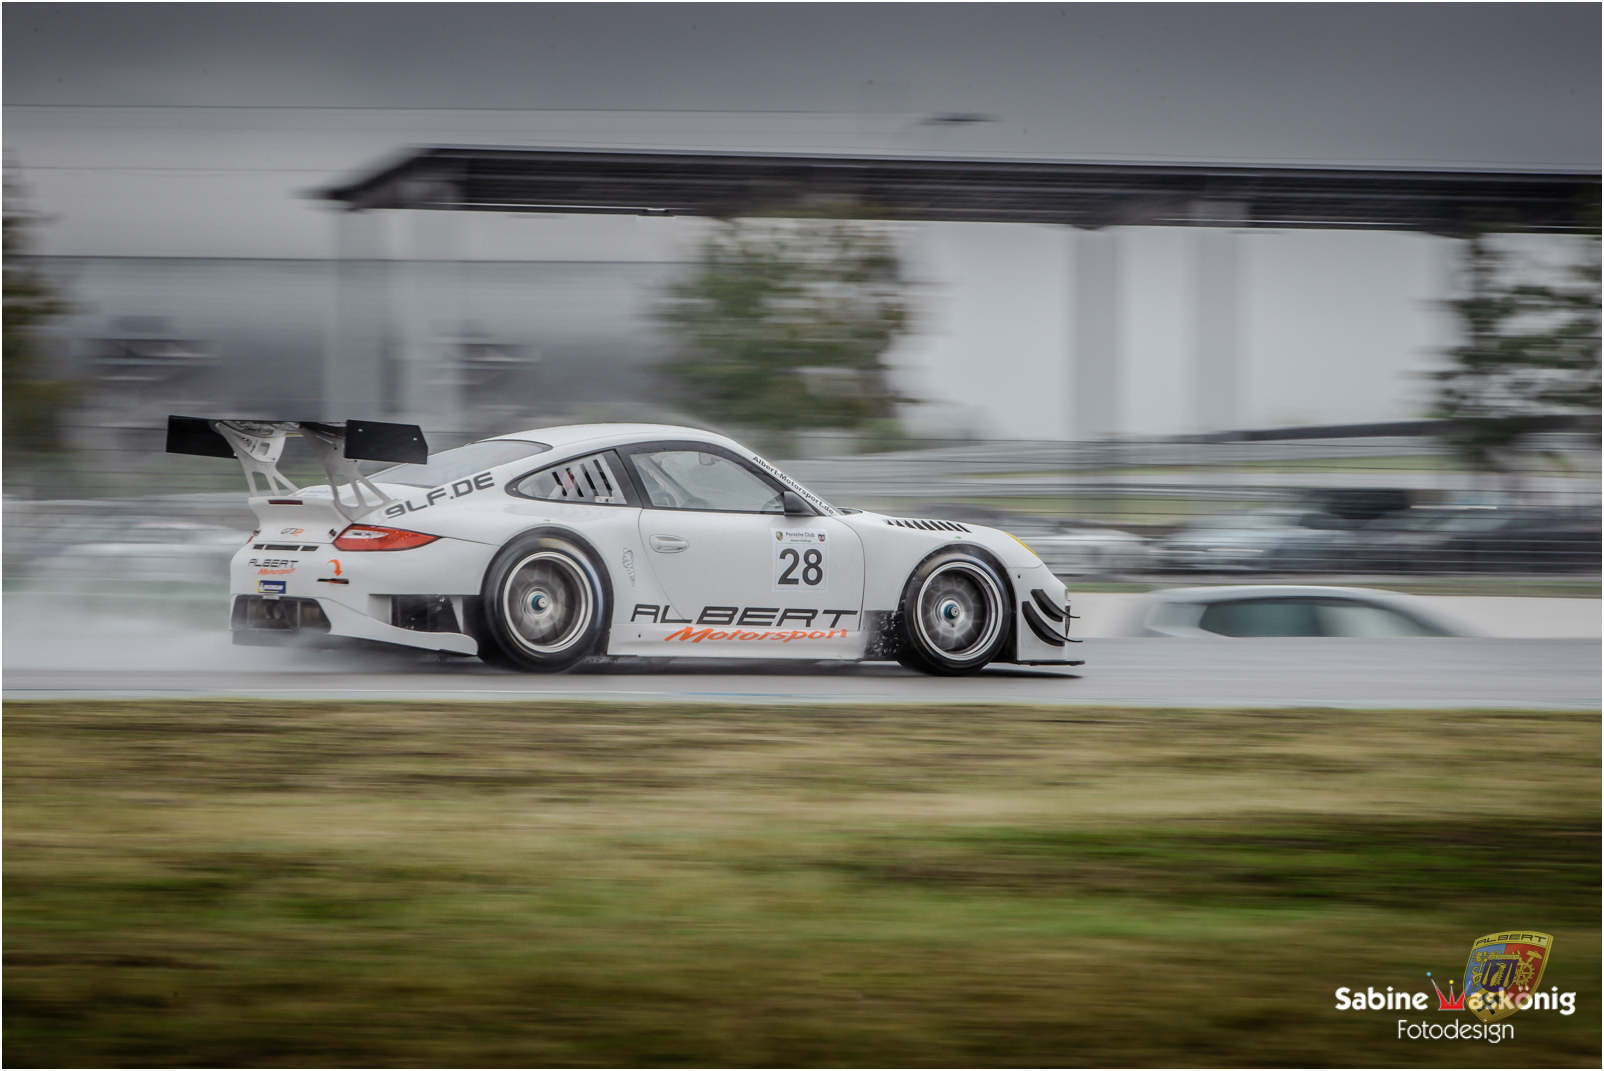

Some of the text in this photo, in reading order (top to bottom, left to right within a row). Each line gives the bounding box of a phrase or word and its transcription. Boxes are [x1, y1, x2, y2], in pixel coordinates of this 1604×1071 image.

[385, 471, 495, 519] 9LF.DE
[752, 455, 834, 515] Albert-Motorsport.de
[248, 558, 299, 568] ALBERT
[777, 548, 823, 586] 28
[630, 603, 858, 629] ALBERT
[664, 626, 848, 643] Motorsport
